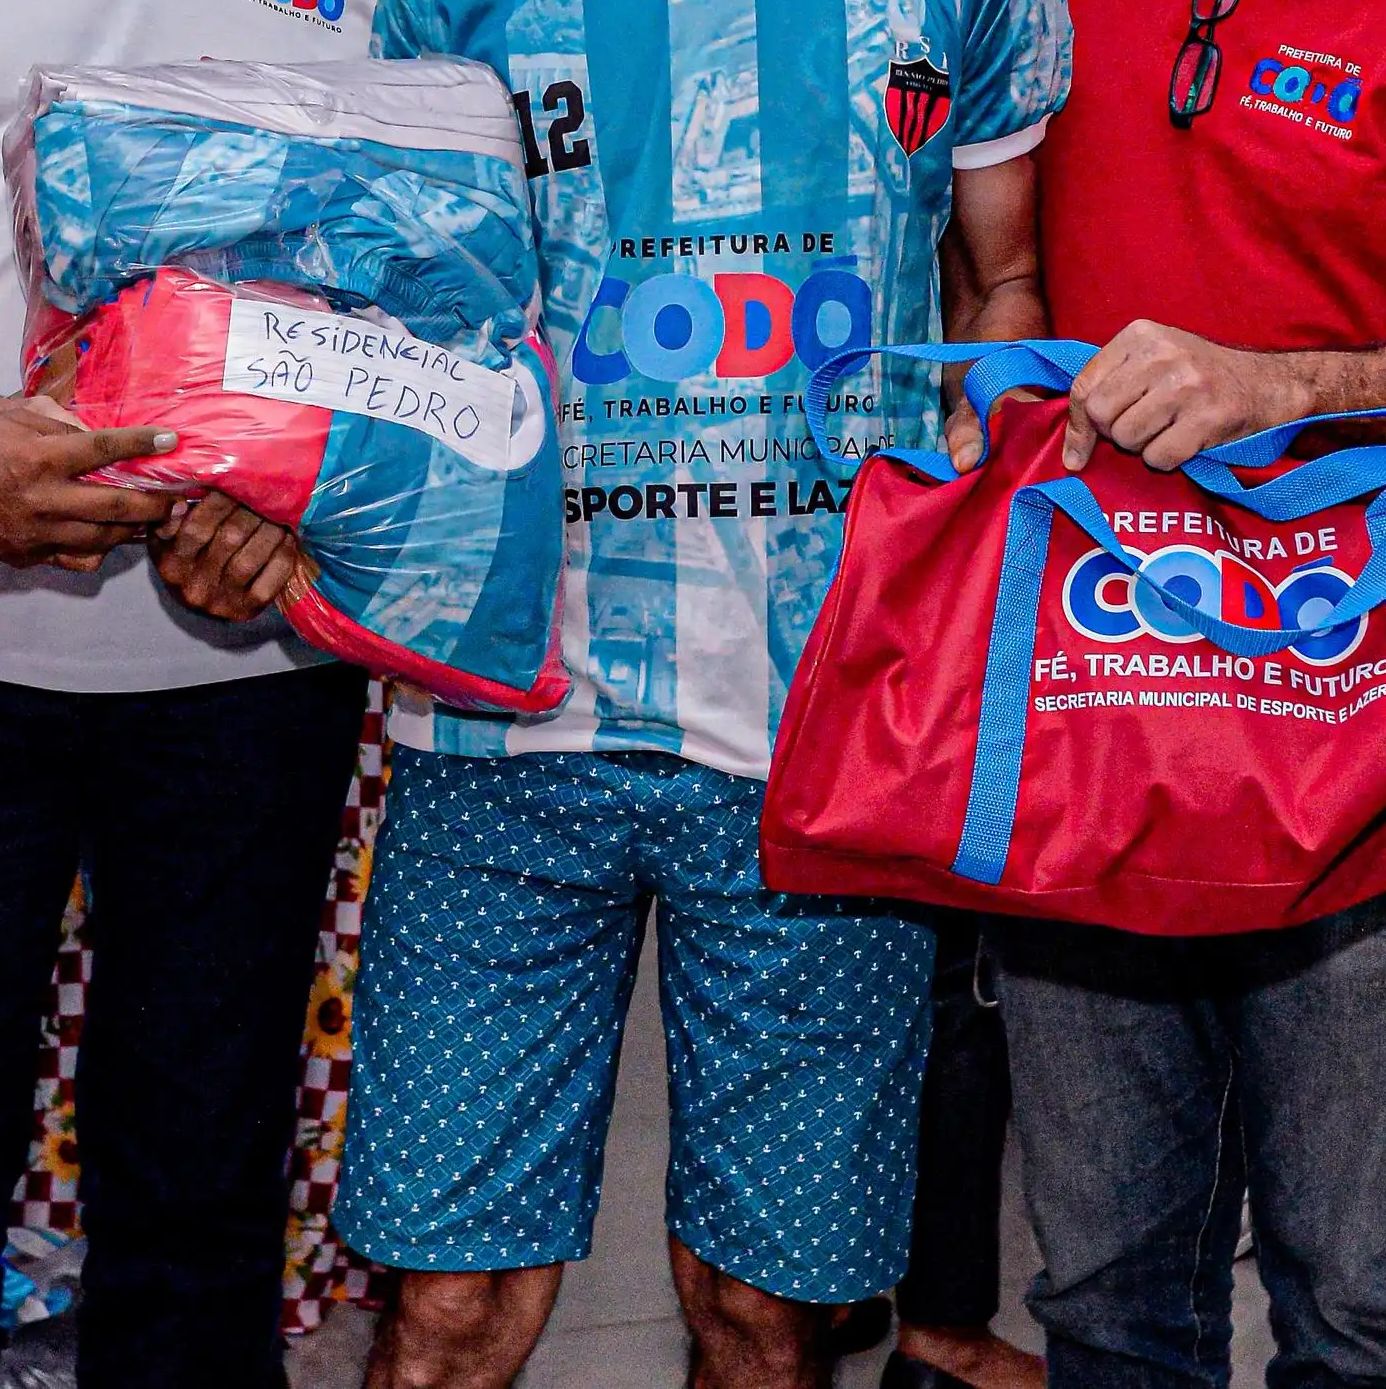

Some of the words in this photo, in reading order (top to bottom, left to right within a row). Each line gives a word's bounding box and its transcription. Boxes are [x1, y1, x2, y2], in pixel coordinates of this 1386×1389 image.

[304, 14, 310, 22] E
[312, 16, 343, 34] FUTURO
[1278, 43, 1343, 69] PREFEITURA
[1344, 61, 1362, 77] DE
[512, 80, 592, 180] 12
[1254, 98, 1304, 123] TRABALHO
[1304, 116, 1314, 128] E
[1314, 120, 1353, 141] FUTURO
[801, 232, 835, 254] DE
[246, 350, 313, 393] SÃO
[344, 366, 481, 439] PEDRO
[561, 398, 593, 423] FÉ,
[604, 395, 748, 418] TRABALHO
[759, 395, 773, 415] E
[563, 439, 711, 470] CRETARIA
[565, 481, 739, 524] SPORTE
[750, 481, 778, 518] E
[1293, 527, 1339, 556] DE
[1034, 651, 1077, 683] FÉ,
[1083, 653, 1256, 681] TRABALHO
[1263, 661, 1283, 685] E
[1034, 690, 1135, 712] SECRETARIA
[1138, 690, 1233, 708] MUNICIPAL
[1236, 694, 1257, 711] DE
[1260, 697, 1338, 726] ESPORTE
[1338, 707, 1348, 724] E
